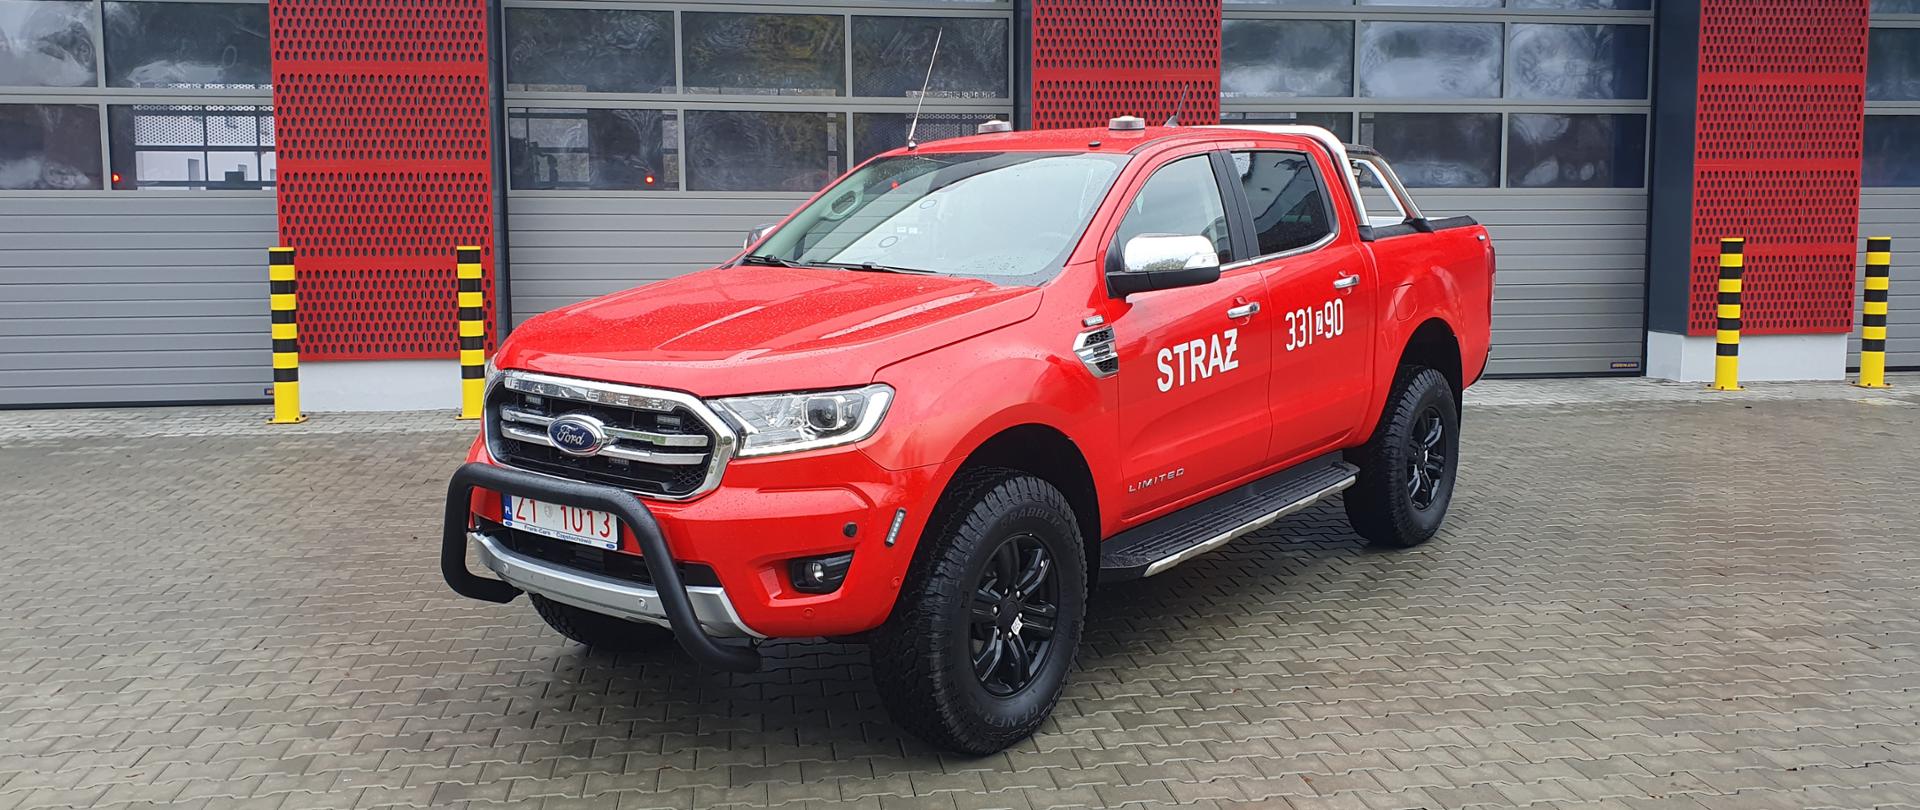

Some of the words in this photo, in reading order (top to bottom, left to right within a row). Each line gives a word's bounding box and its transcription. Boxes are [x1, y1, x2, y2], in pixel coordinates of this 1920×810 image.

[1157, 328, 1239, 393] STRAŻ
[557, 424, 586, 446] Ford
[1128, 467, 1185, 493] LIMITED
[560, 505, 611, 538] 1013
